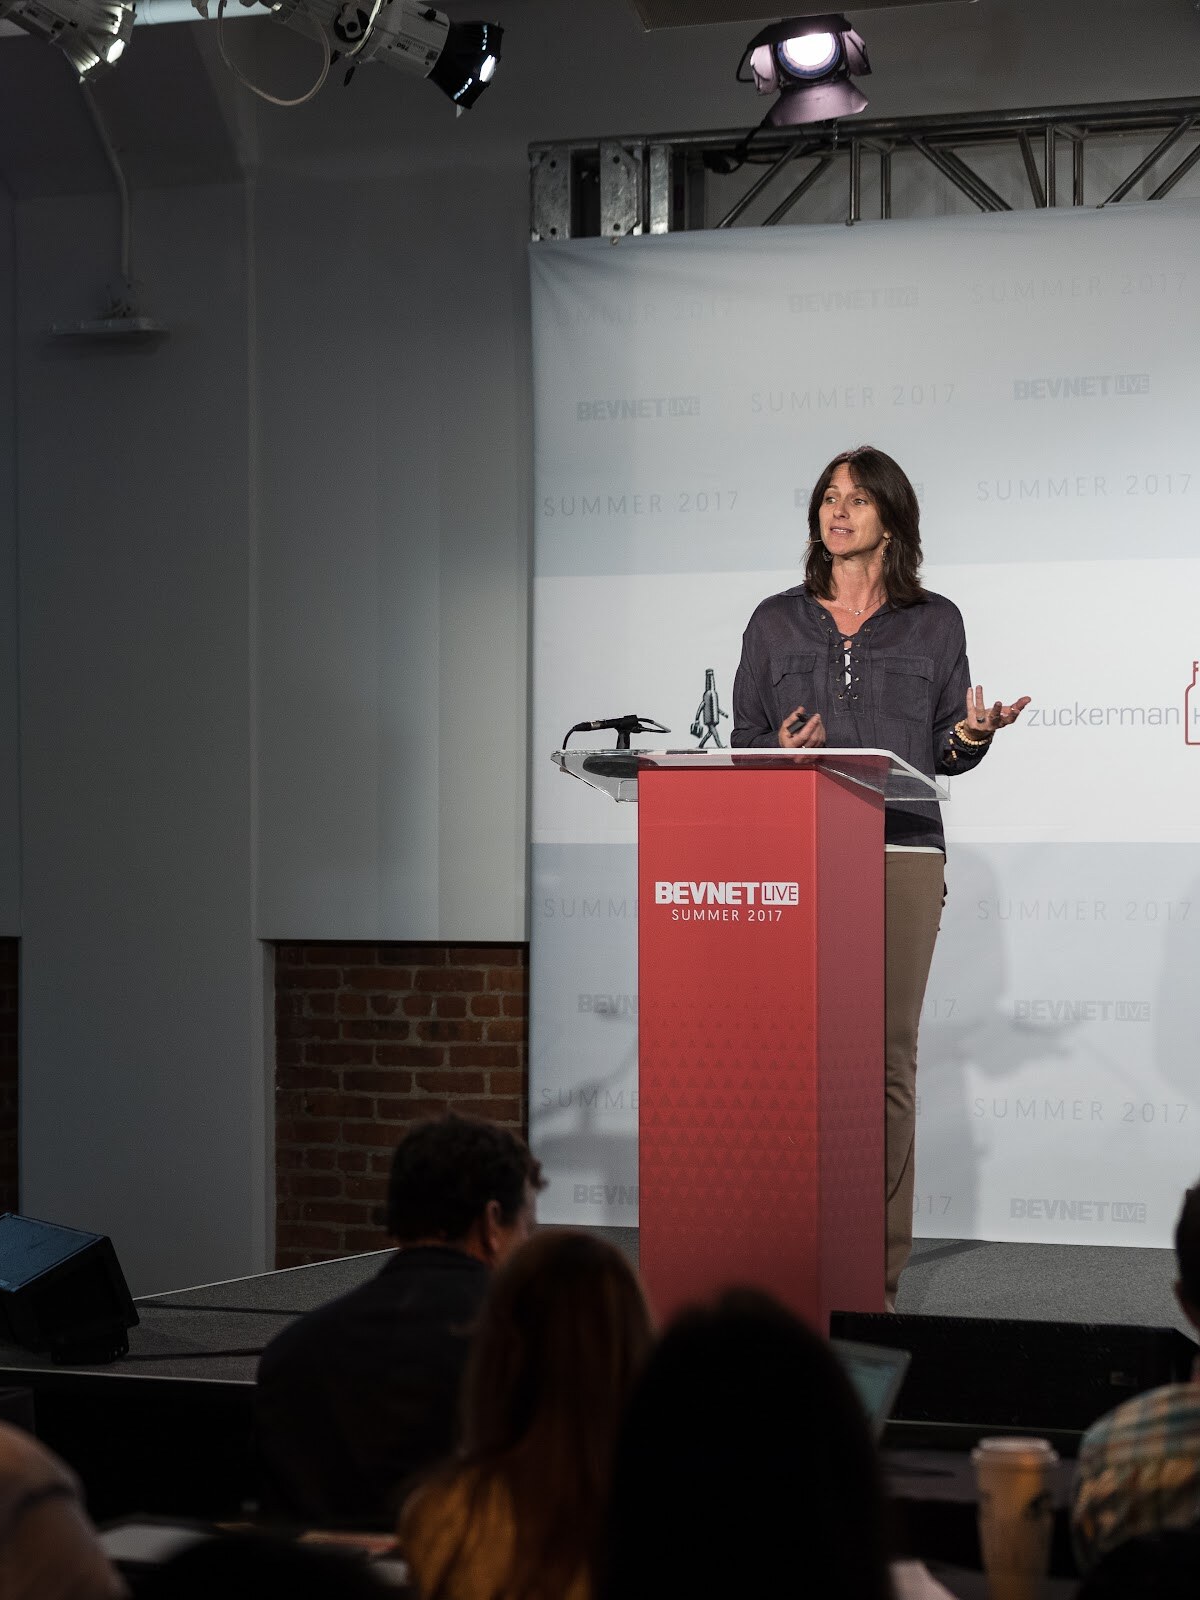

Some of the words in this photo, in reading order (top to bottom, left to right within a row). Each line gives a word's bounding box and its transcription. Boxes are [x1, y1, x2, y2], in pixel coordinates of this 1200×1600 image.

[970, 277, 1100, 304] SUMMER
[1121, 272, 1188, 296] 2017
[788, 289, 880, 313] BEVNET
[751, 387, 875, 413] SUMMER
[892, 384, 956, 406] 2017
[1013, 375, 1111, 400] BEVNET
[1114, 373, 1150, 395] LIVE
[577, 399, 665, 421] BEVNET
[668, 396, 700, 417] LIVE
[977, 476, 1107, 502] SUMMER
[1126, 472, 1192, 496] 2017
[544, 493, 662, 517] SUMMER
[678, 491, 740, 512] 2017
[1027, 701, 1180, 726] zuckerman
[655, 882, 759, 904] BEVNET
[763, 883, 798, 903] LIVE
[544, 899, 638, 918] SUMM
[672, 909, 739, 921] SUMMER
[748, 910, 782, 922] 2017
[977, 899, 1108, 921] SUMMER
[1125, 901, 1192, 922] 2017
[577, 993, 638, 1013] BEVN
[1015, 1000, 1112, 1021] BEVNET
[1115, 1000, 1151, 1022] LIVE
[542, 1088, 638, 1109] SUMME
[974, 1098, 1104, 1121] SUMMER
[1122, 1101, 1189, 1123] 2017
[573, 1184, 638, 1205] BEVN
[1010, 1197, 1110, 1223] BEVNET
[1111, 1201, 1147, 1223] LIVE
